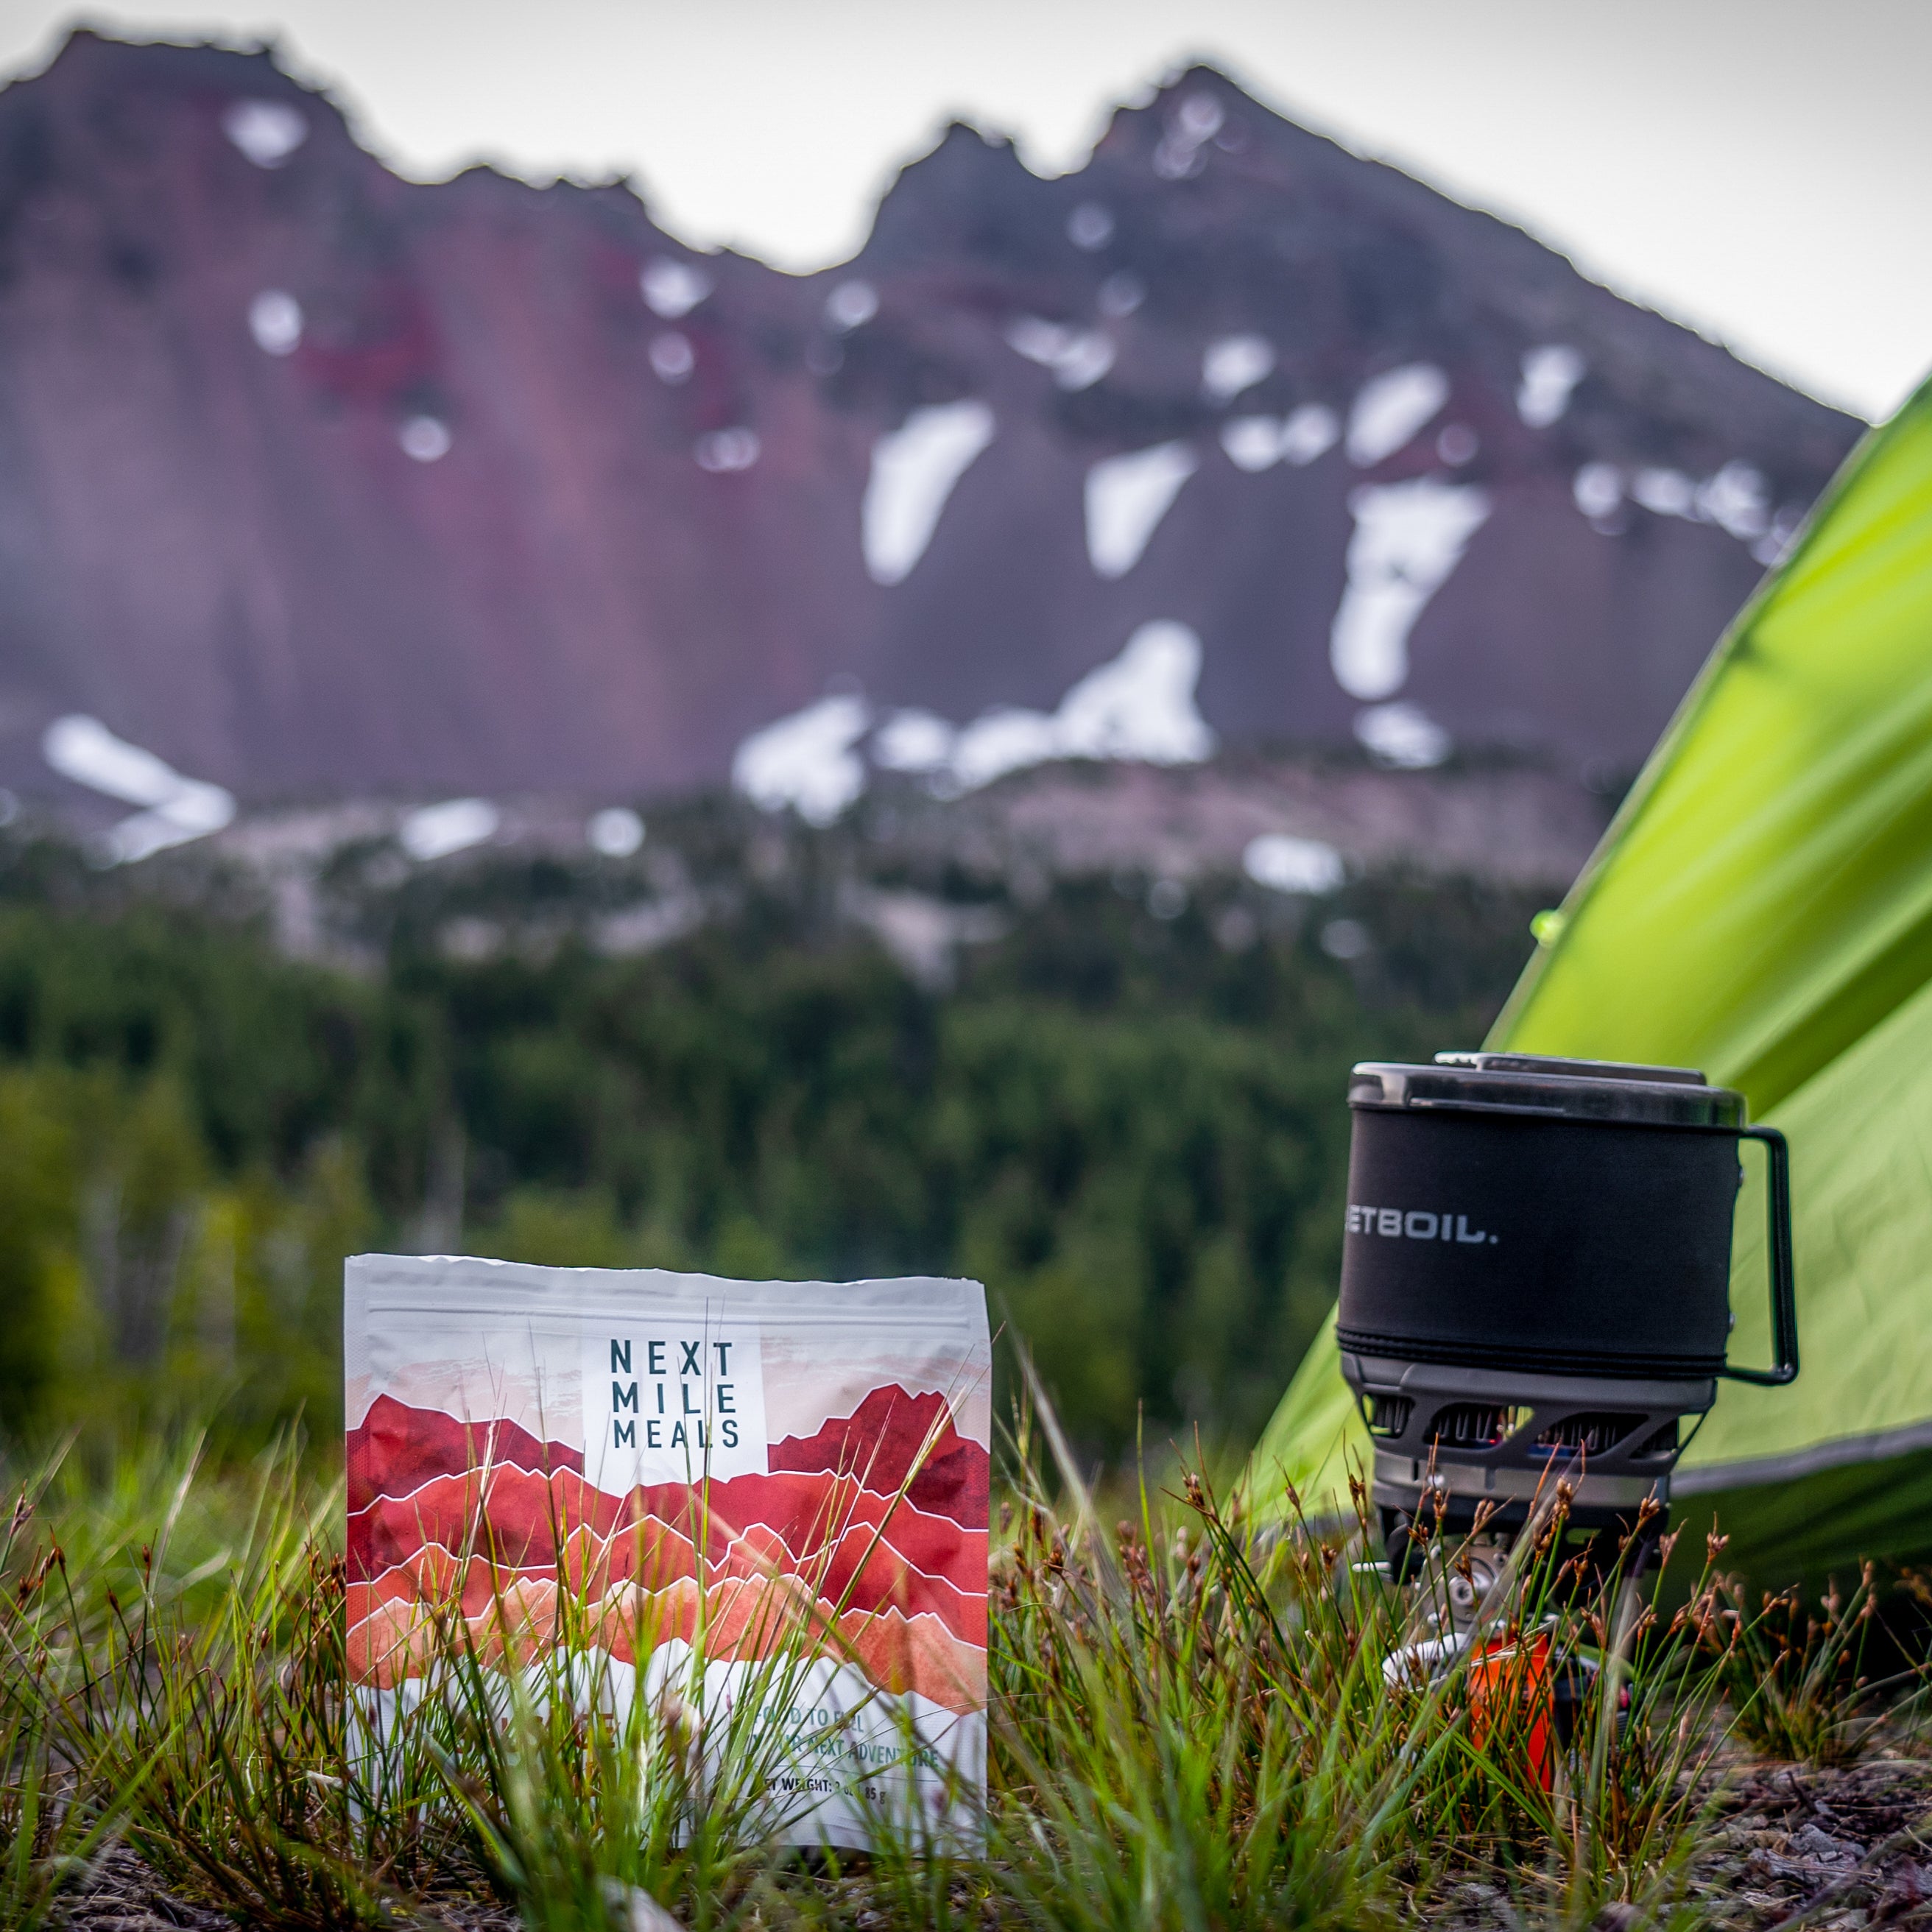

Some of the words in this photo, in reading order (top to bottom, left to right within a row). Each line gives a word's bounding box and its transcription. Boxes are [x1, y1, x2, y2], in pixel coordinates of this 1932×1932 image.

[1345, 1204, 1498, 1244] ETBOIL.
[610, 1339, 733, 1376] NEXT
[612, 1381, 736, 1414] MILE
[613, 1419, 738, 1448] MEALS
[808, 1707, 828, 1727] TO
[781, 1777, 832, 1792] WEGHT:
[865, 1786, 877, 1800] 85
